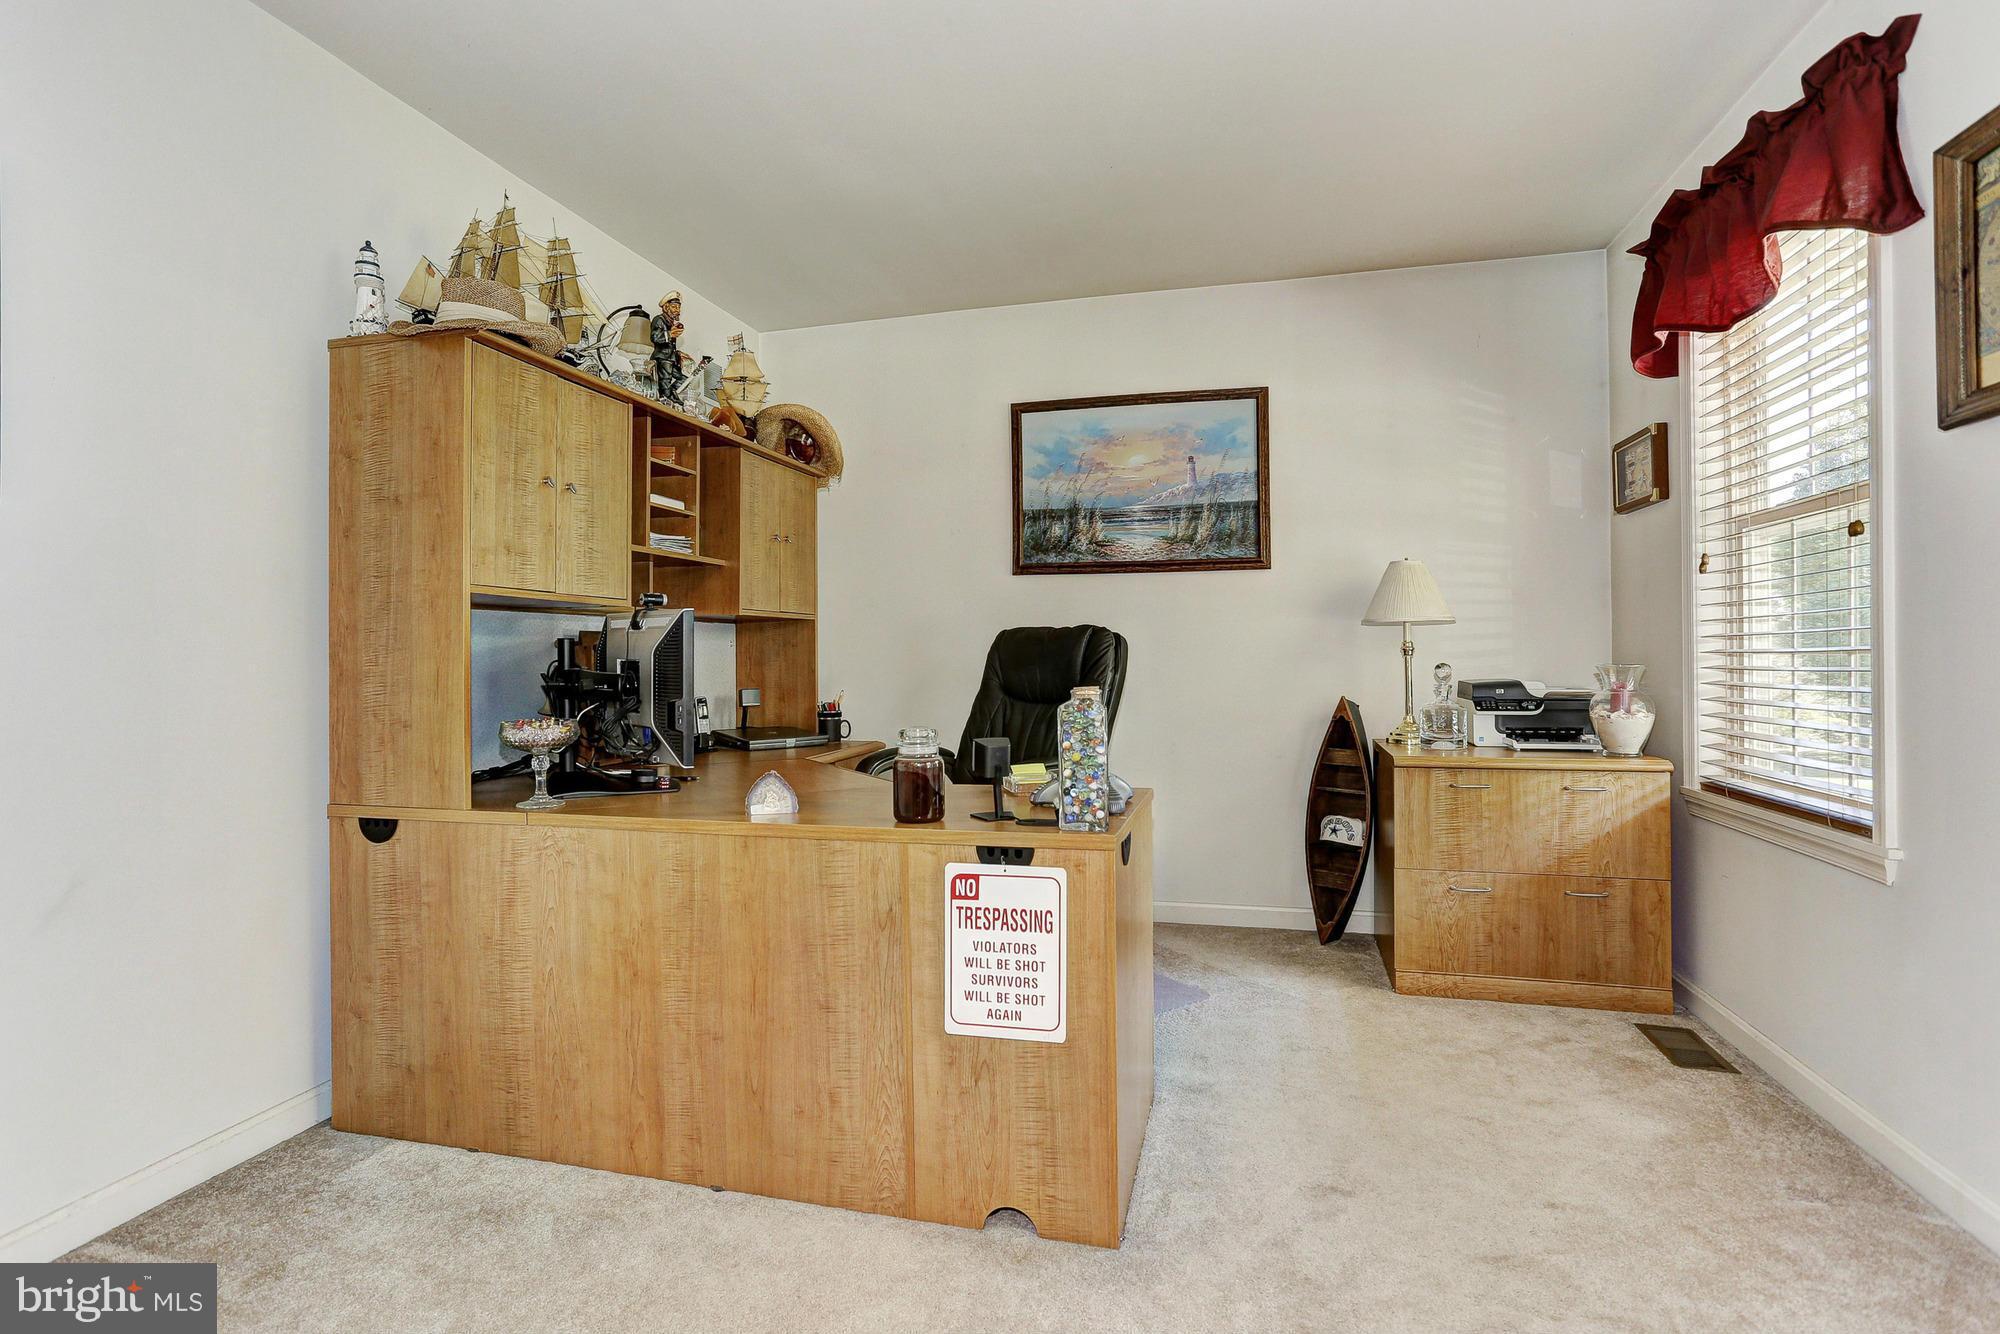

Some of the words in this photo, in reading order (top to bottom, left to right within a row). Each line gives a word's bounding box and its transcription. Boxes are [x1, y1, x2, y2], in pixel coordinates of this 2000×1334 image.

[955, 879, 977, 897] NO
[956, 906, 1053, 934] TRESPASSING
[973, 940, 1037, 955] VIOLATORS
[964, 956, 992, 969] WILL
[997, 958, 1010, 970] BE
[1015, 959, 1046, 973] SHOT
[971, 973, 1038, 989] SURVIVORS
[964, 990, 992, 1003] WILL
[997, 992, 1010, 1004] BE
[1015, 993, 1046, 1007] SHOT
[987, 1008, 1022, 1021] AGAIN
